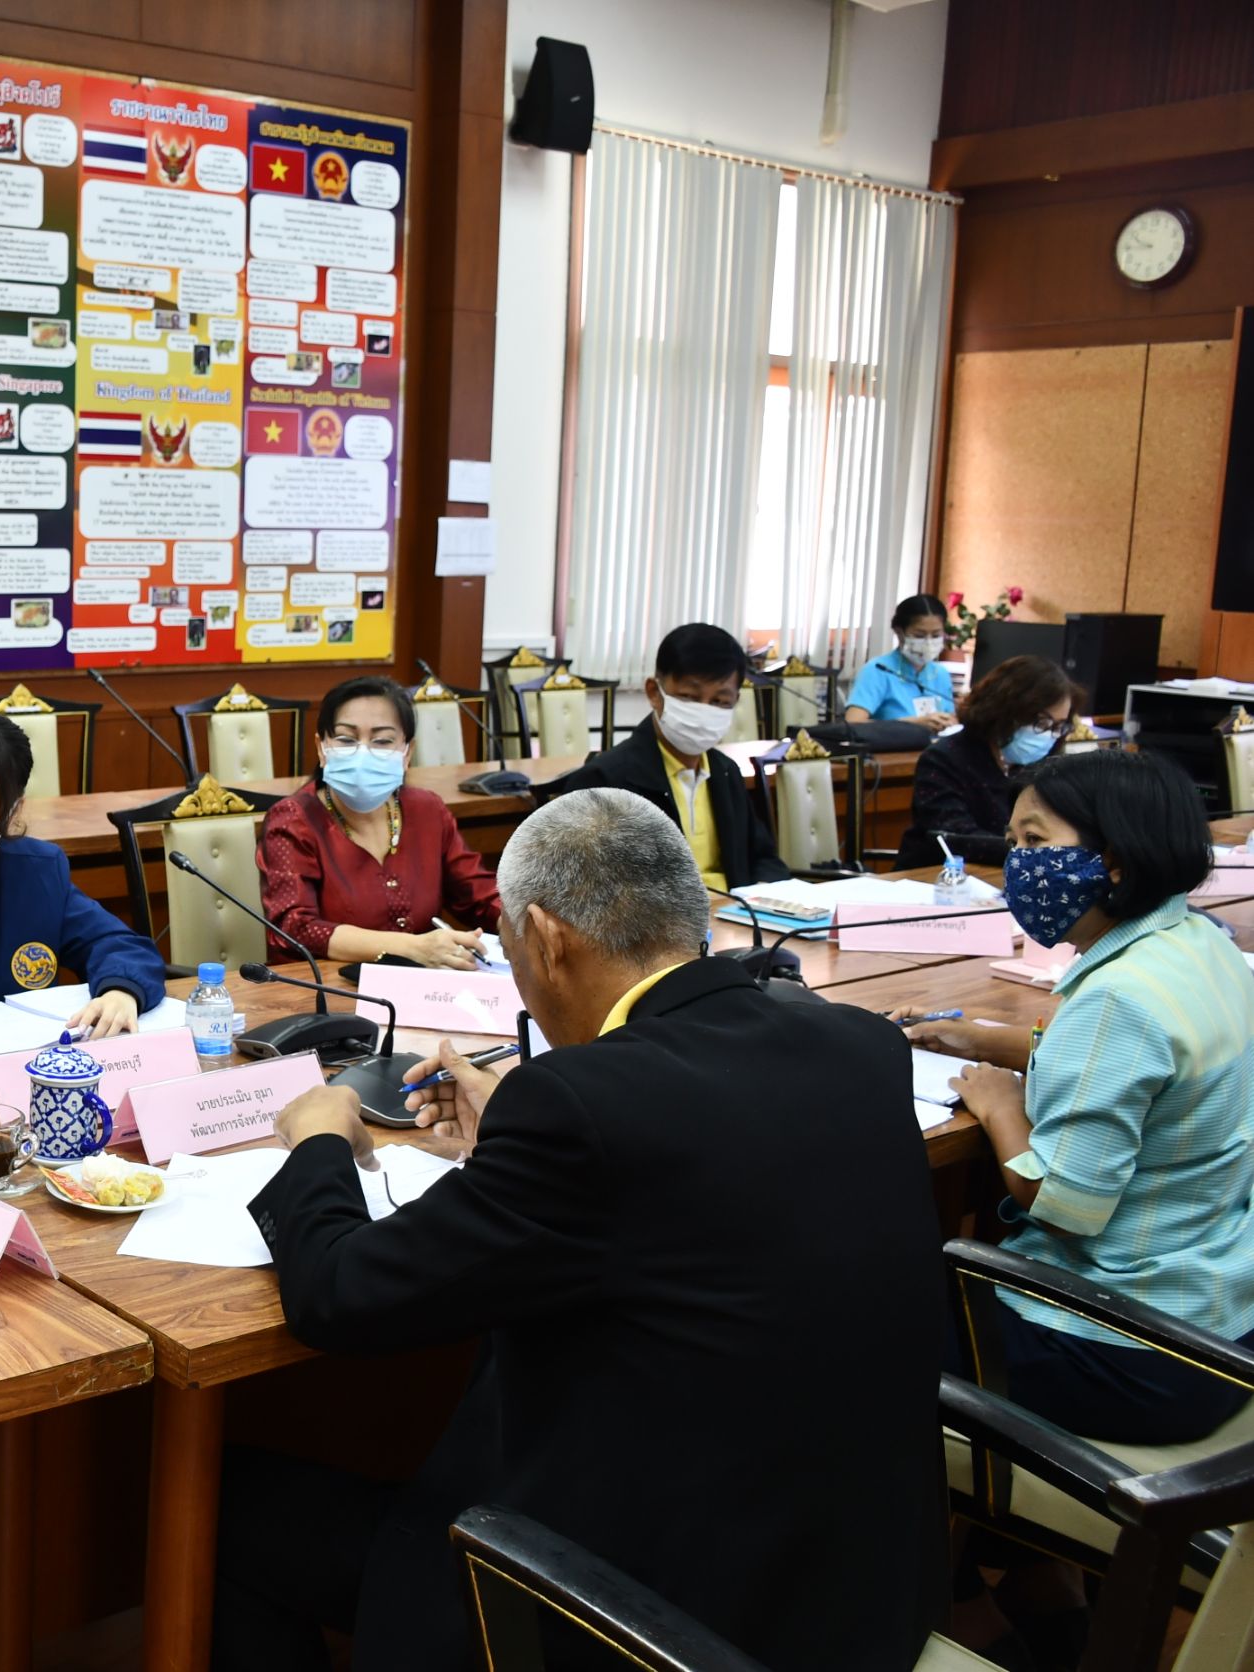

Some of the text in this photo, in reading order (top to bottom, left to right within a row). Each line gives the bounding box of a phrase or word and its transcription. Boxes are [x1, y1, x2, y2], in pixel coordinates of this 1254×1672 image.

[110, 98, 228, 131] ราชอาณาจักรไทย
[96, 382, 231, 404] Kingdom of Thailand
[196, 1086, 274, 1111] นายประเมิน อุมา
